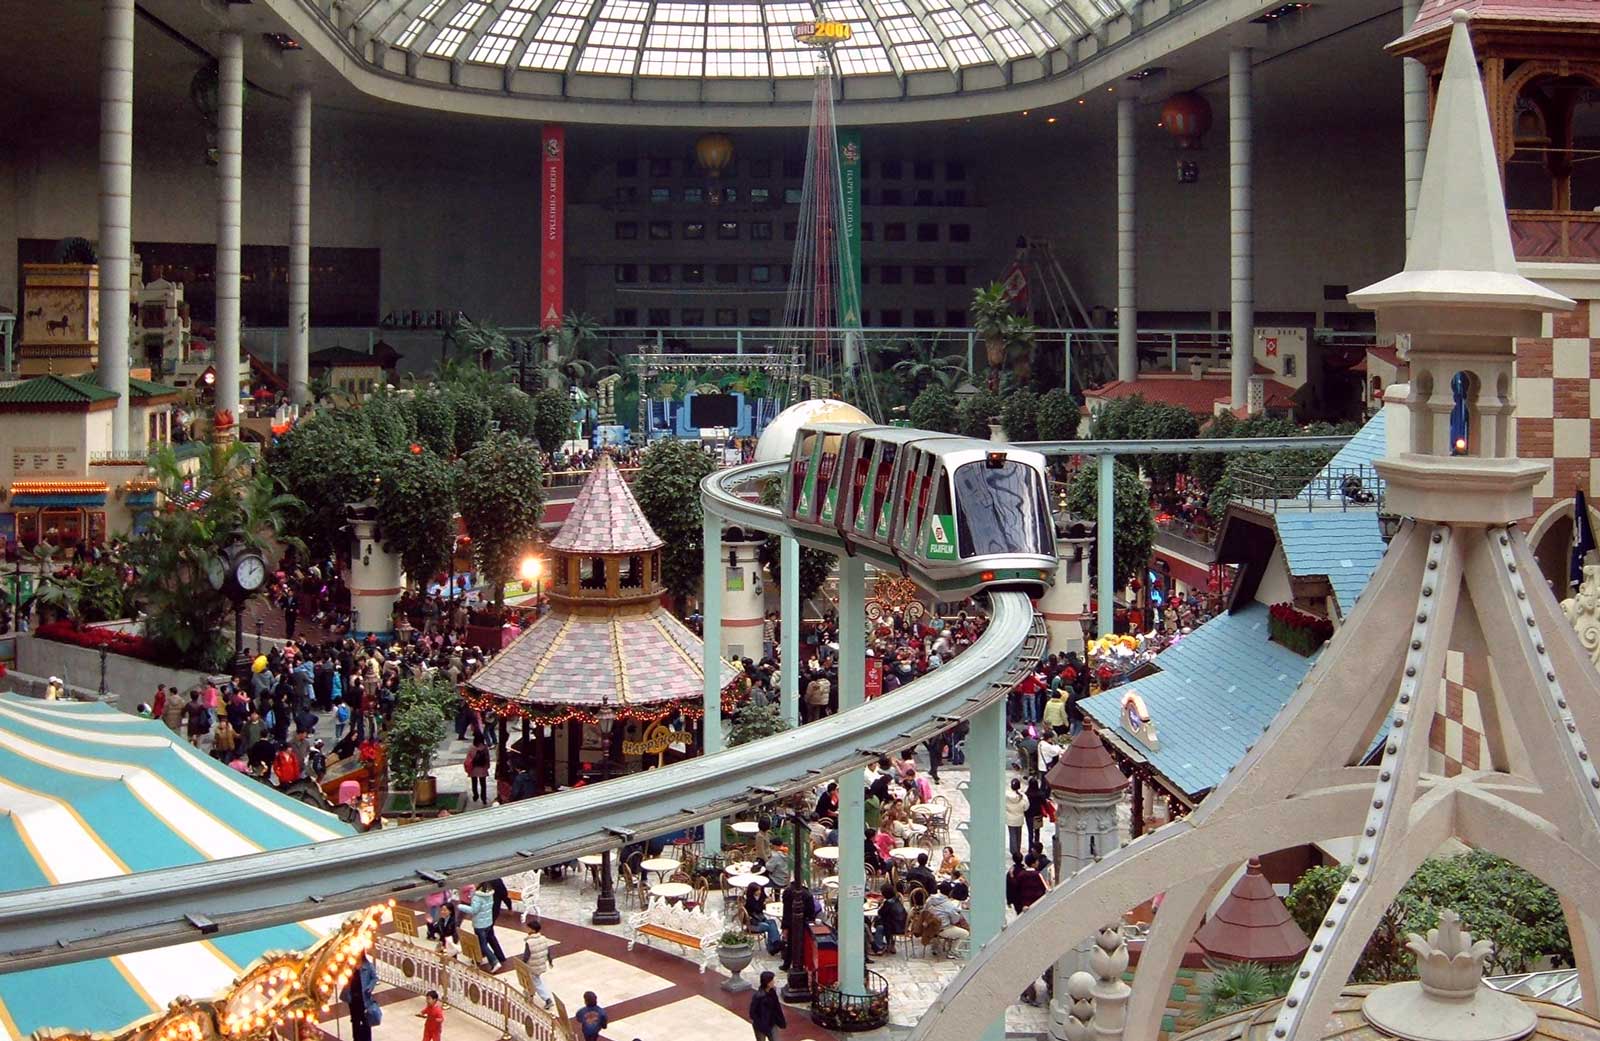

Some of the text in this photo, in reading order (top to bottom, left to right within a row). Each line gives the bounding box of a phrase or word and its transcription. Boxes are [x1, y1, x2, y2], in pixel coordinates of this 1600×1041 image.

[549, 166, 558, 192] MERRY
[549, 194, 558, 241] CHRISTMAS
[846, 197, 854, 238] HOLIDAYS
